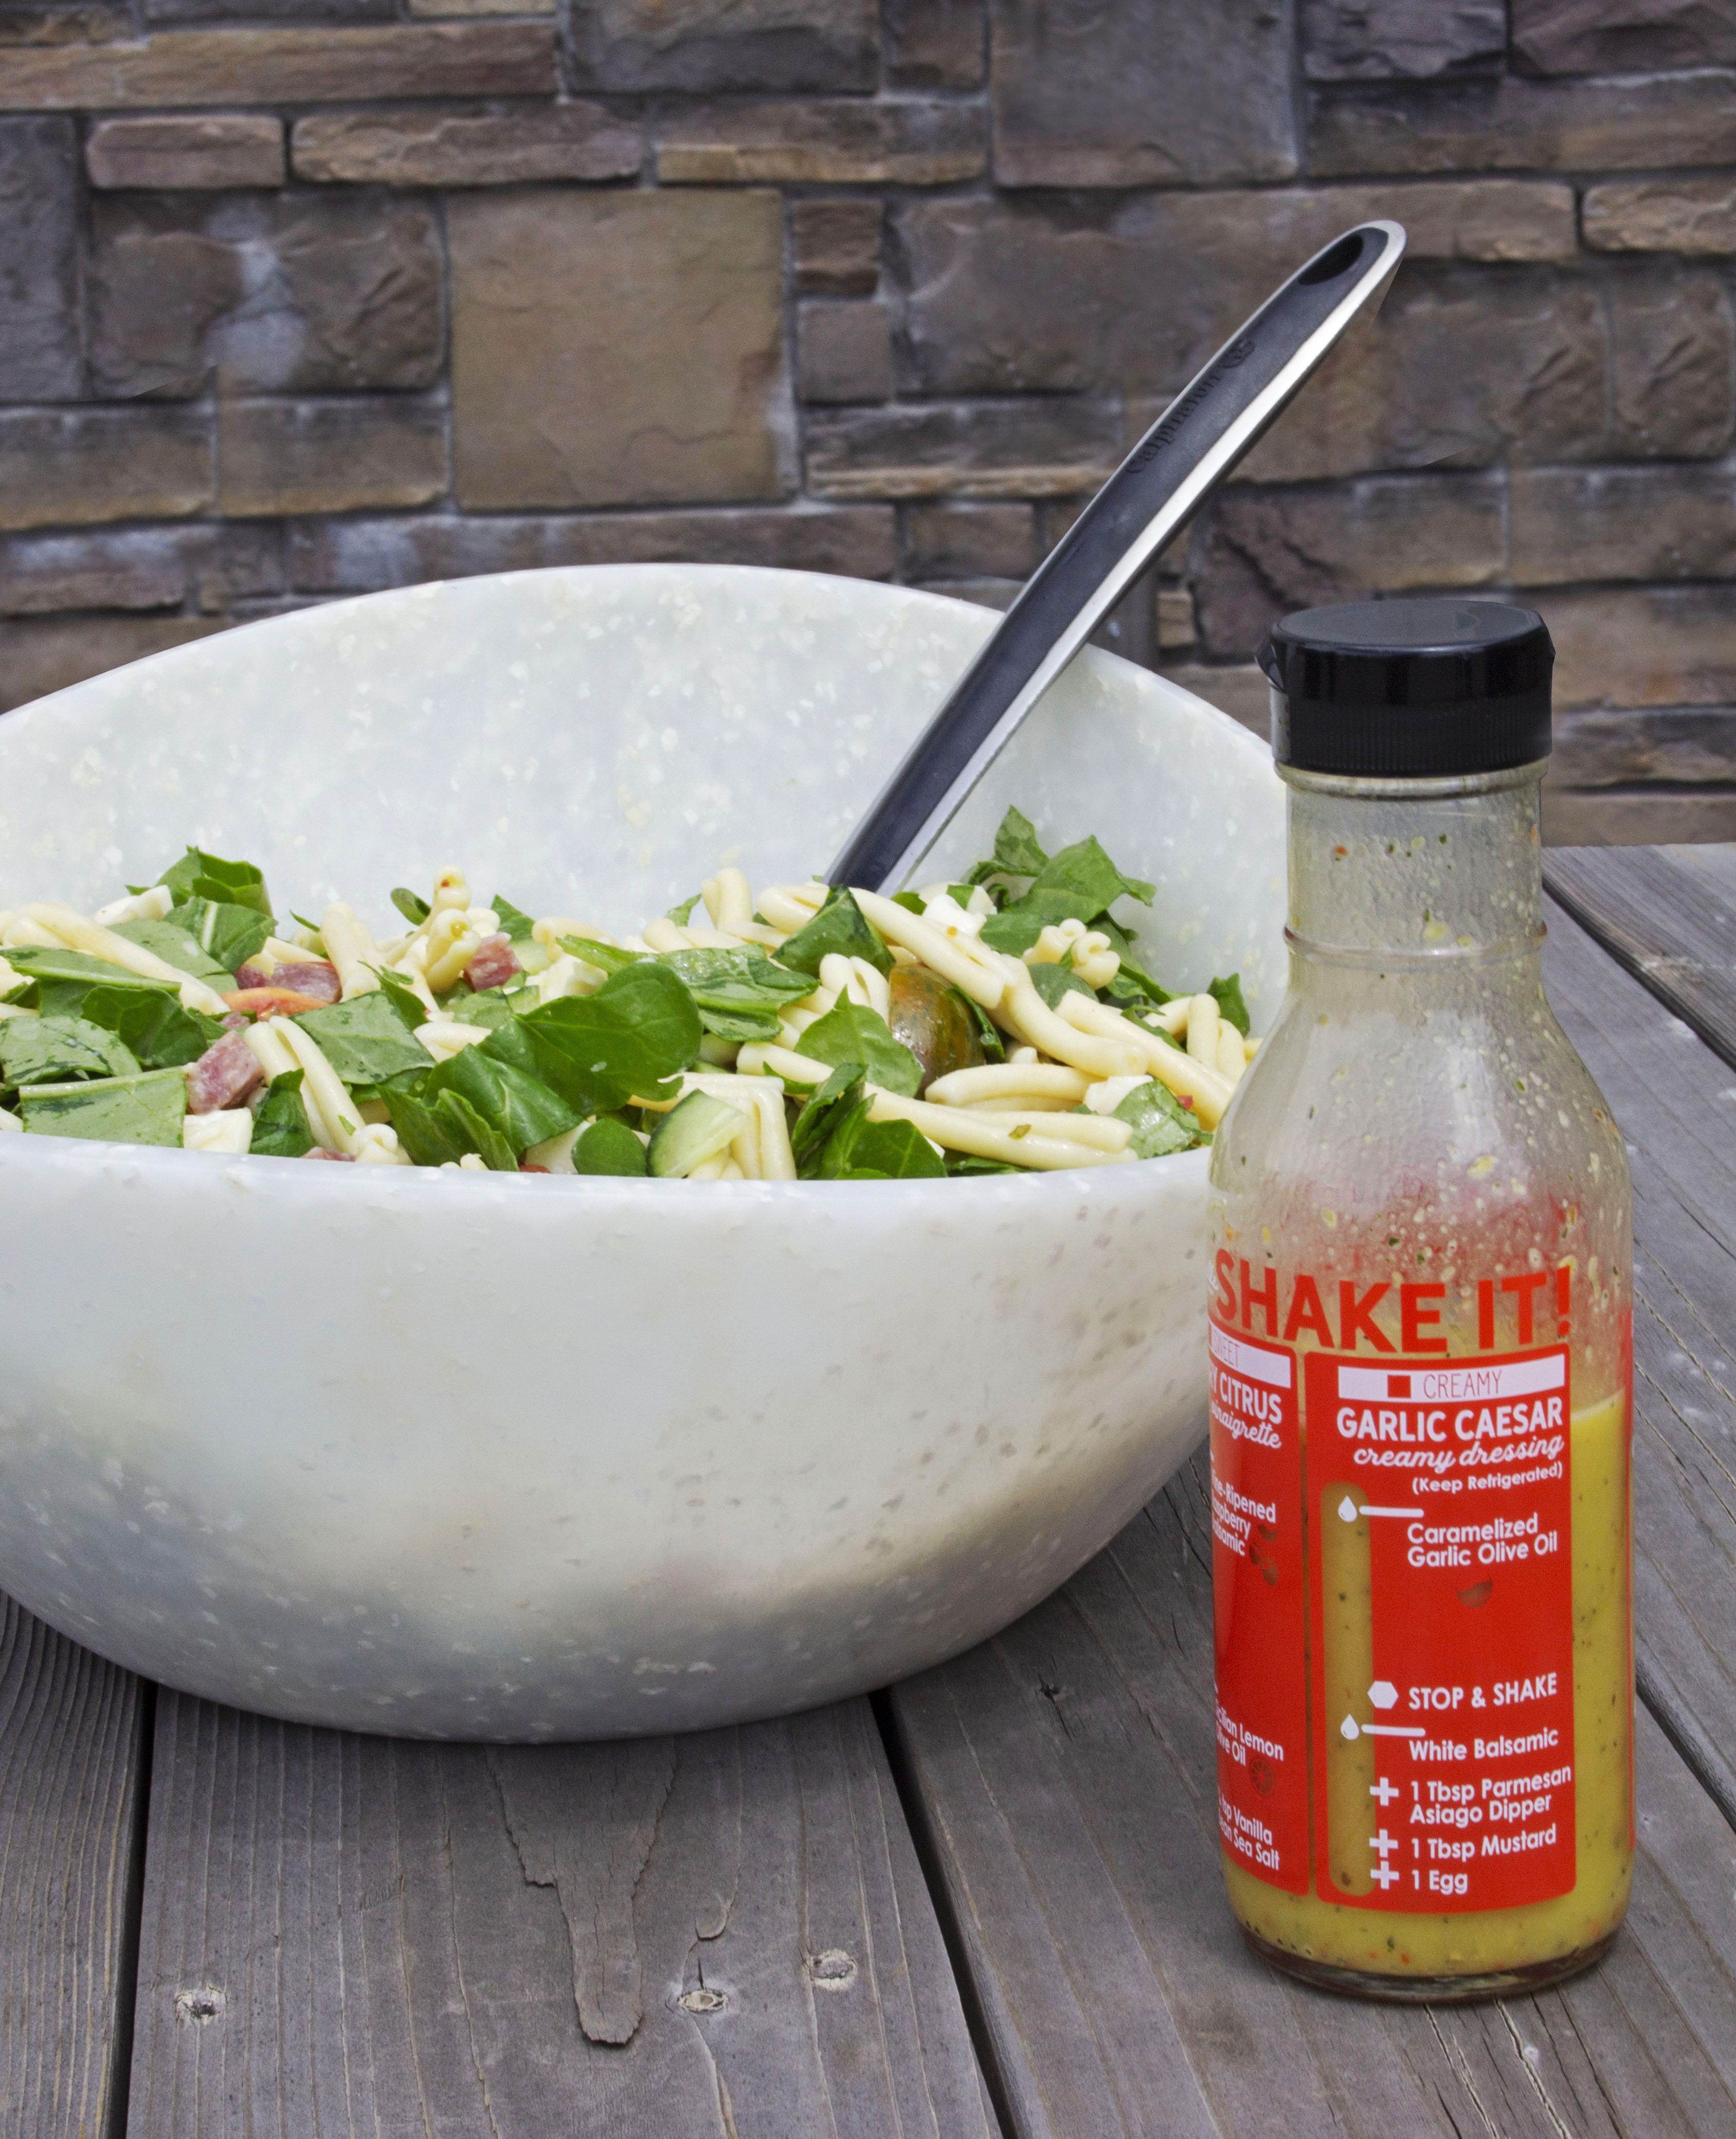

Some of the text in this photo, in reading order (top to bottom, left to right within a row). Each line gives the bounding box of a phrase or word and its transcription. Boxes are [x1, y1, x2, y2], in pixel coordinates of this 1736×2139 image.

[1215, 1248, 1571, 1354] SHAKE IT!
[1220, 1371, 1282, 1425] CITRUS
[1423, 1370, 1503, 1400] CREAMY
[1336, 1396, 1562, 1442] GARLIC CAESAR
[1353, 1435, 1564, 1474] creamy dressing
[1412, 1461, 1563, 1495] (Keep Refrigerated)
[1212, 1488, 1251, 1540] aspberry
[1407, 1512, 1538, 1544] Caramelized
[1213, 1511, 1246, 1557] alsamic
[1407, 1530, 1557, 1567] Garlic Olive Oil
[1409, 1672, 1557, 1710] STOP & SHAKE
[1233, 1740, 1246, 1766] Oil
[1240, 1722, 1284, 1762] Lemon
[1409, 1727, 1558, 1761] White Balsamic
[1411, 1766, 1571, 1805] 1 Tbsp Parmesan
[1233, 1805, 1272, 1846] Vanilla
[1410, 1794, 1552, 1828] Asiago Dipper
[1234, 1828, 1253, 1858] Sea
[1256, 1842, 1280, 1870] Salt
[1411, 1823, 1556, 1862] 1 Tbsp Mustard
[1412, 1869, 1468, 1895] 1 Egg
